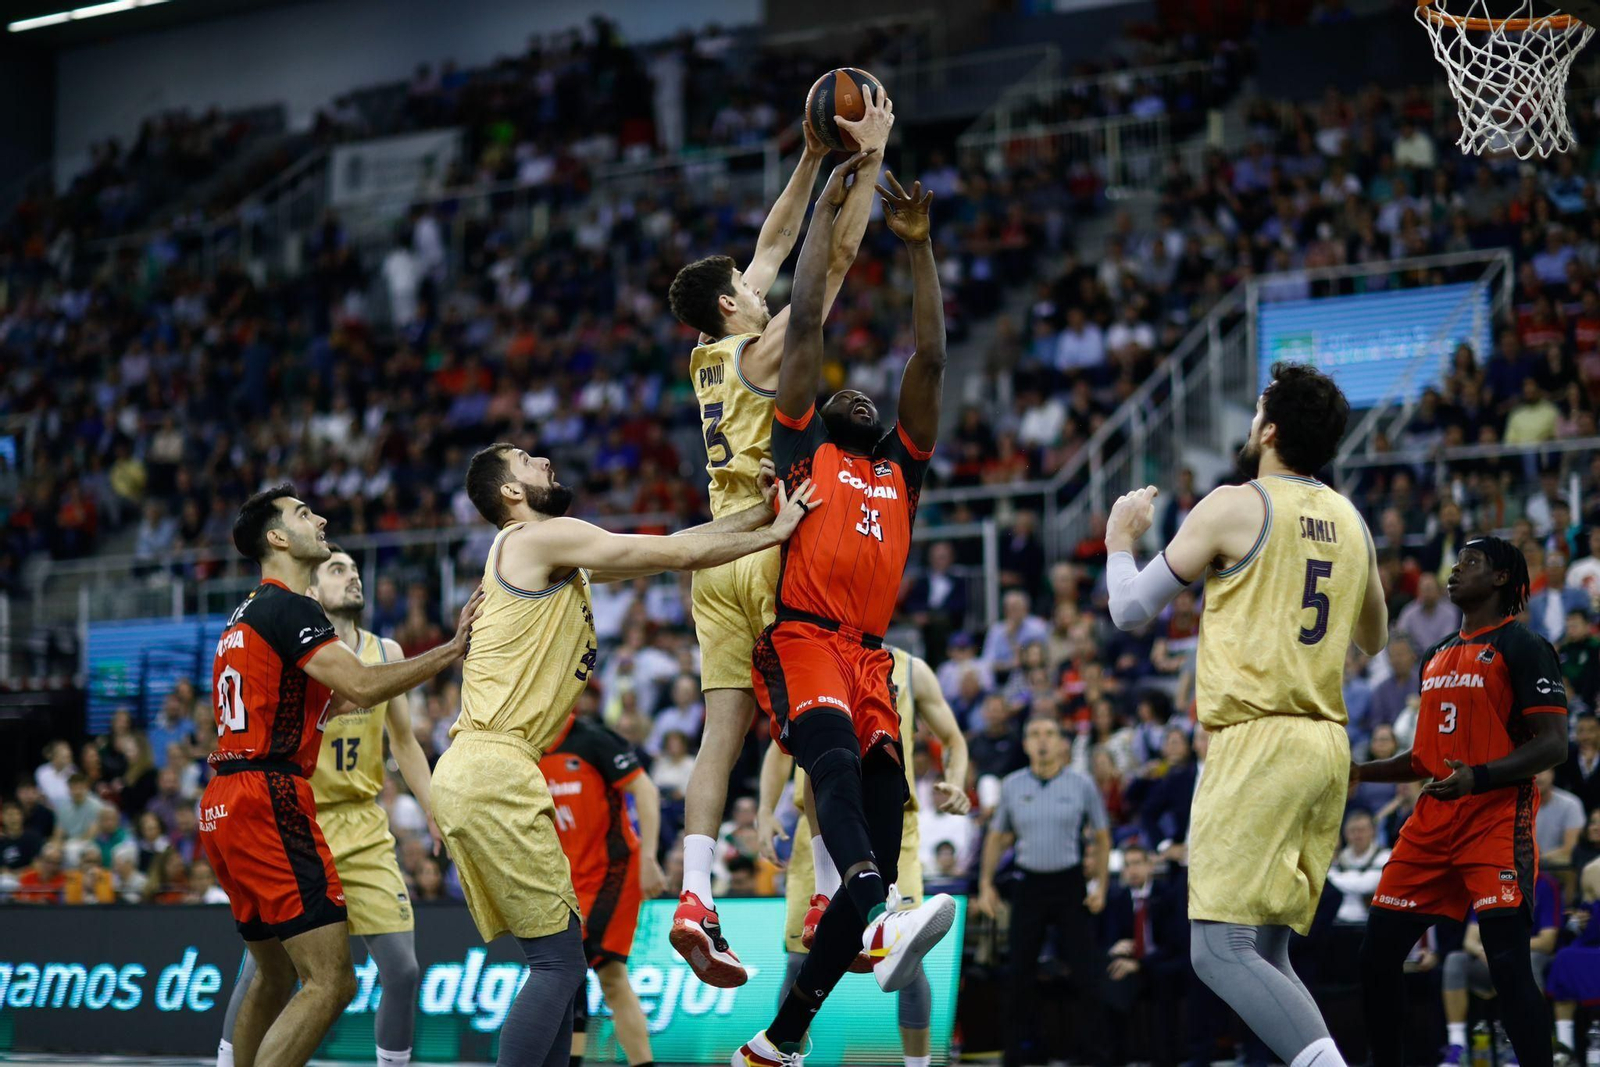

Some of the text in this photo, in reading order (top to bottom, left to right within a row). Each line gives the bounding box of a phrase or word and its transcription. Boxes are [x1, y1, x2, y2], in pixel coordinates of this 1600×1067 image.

[704, 402, 734, 468] 3
[856, 502, 884, 542] 35
[1298, 558, 1333, 646] 5
[1438, 702, 1457, 734] 3
[331, 737, 361, 772] 13
[154, 945, 222, 1012] de
[418, 947, 531, 1033] alg
